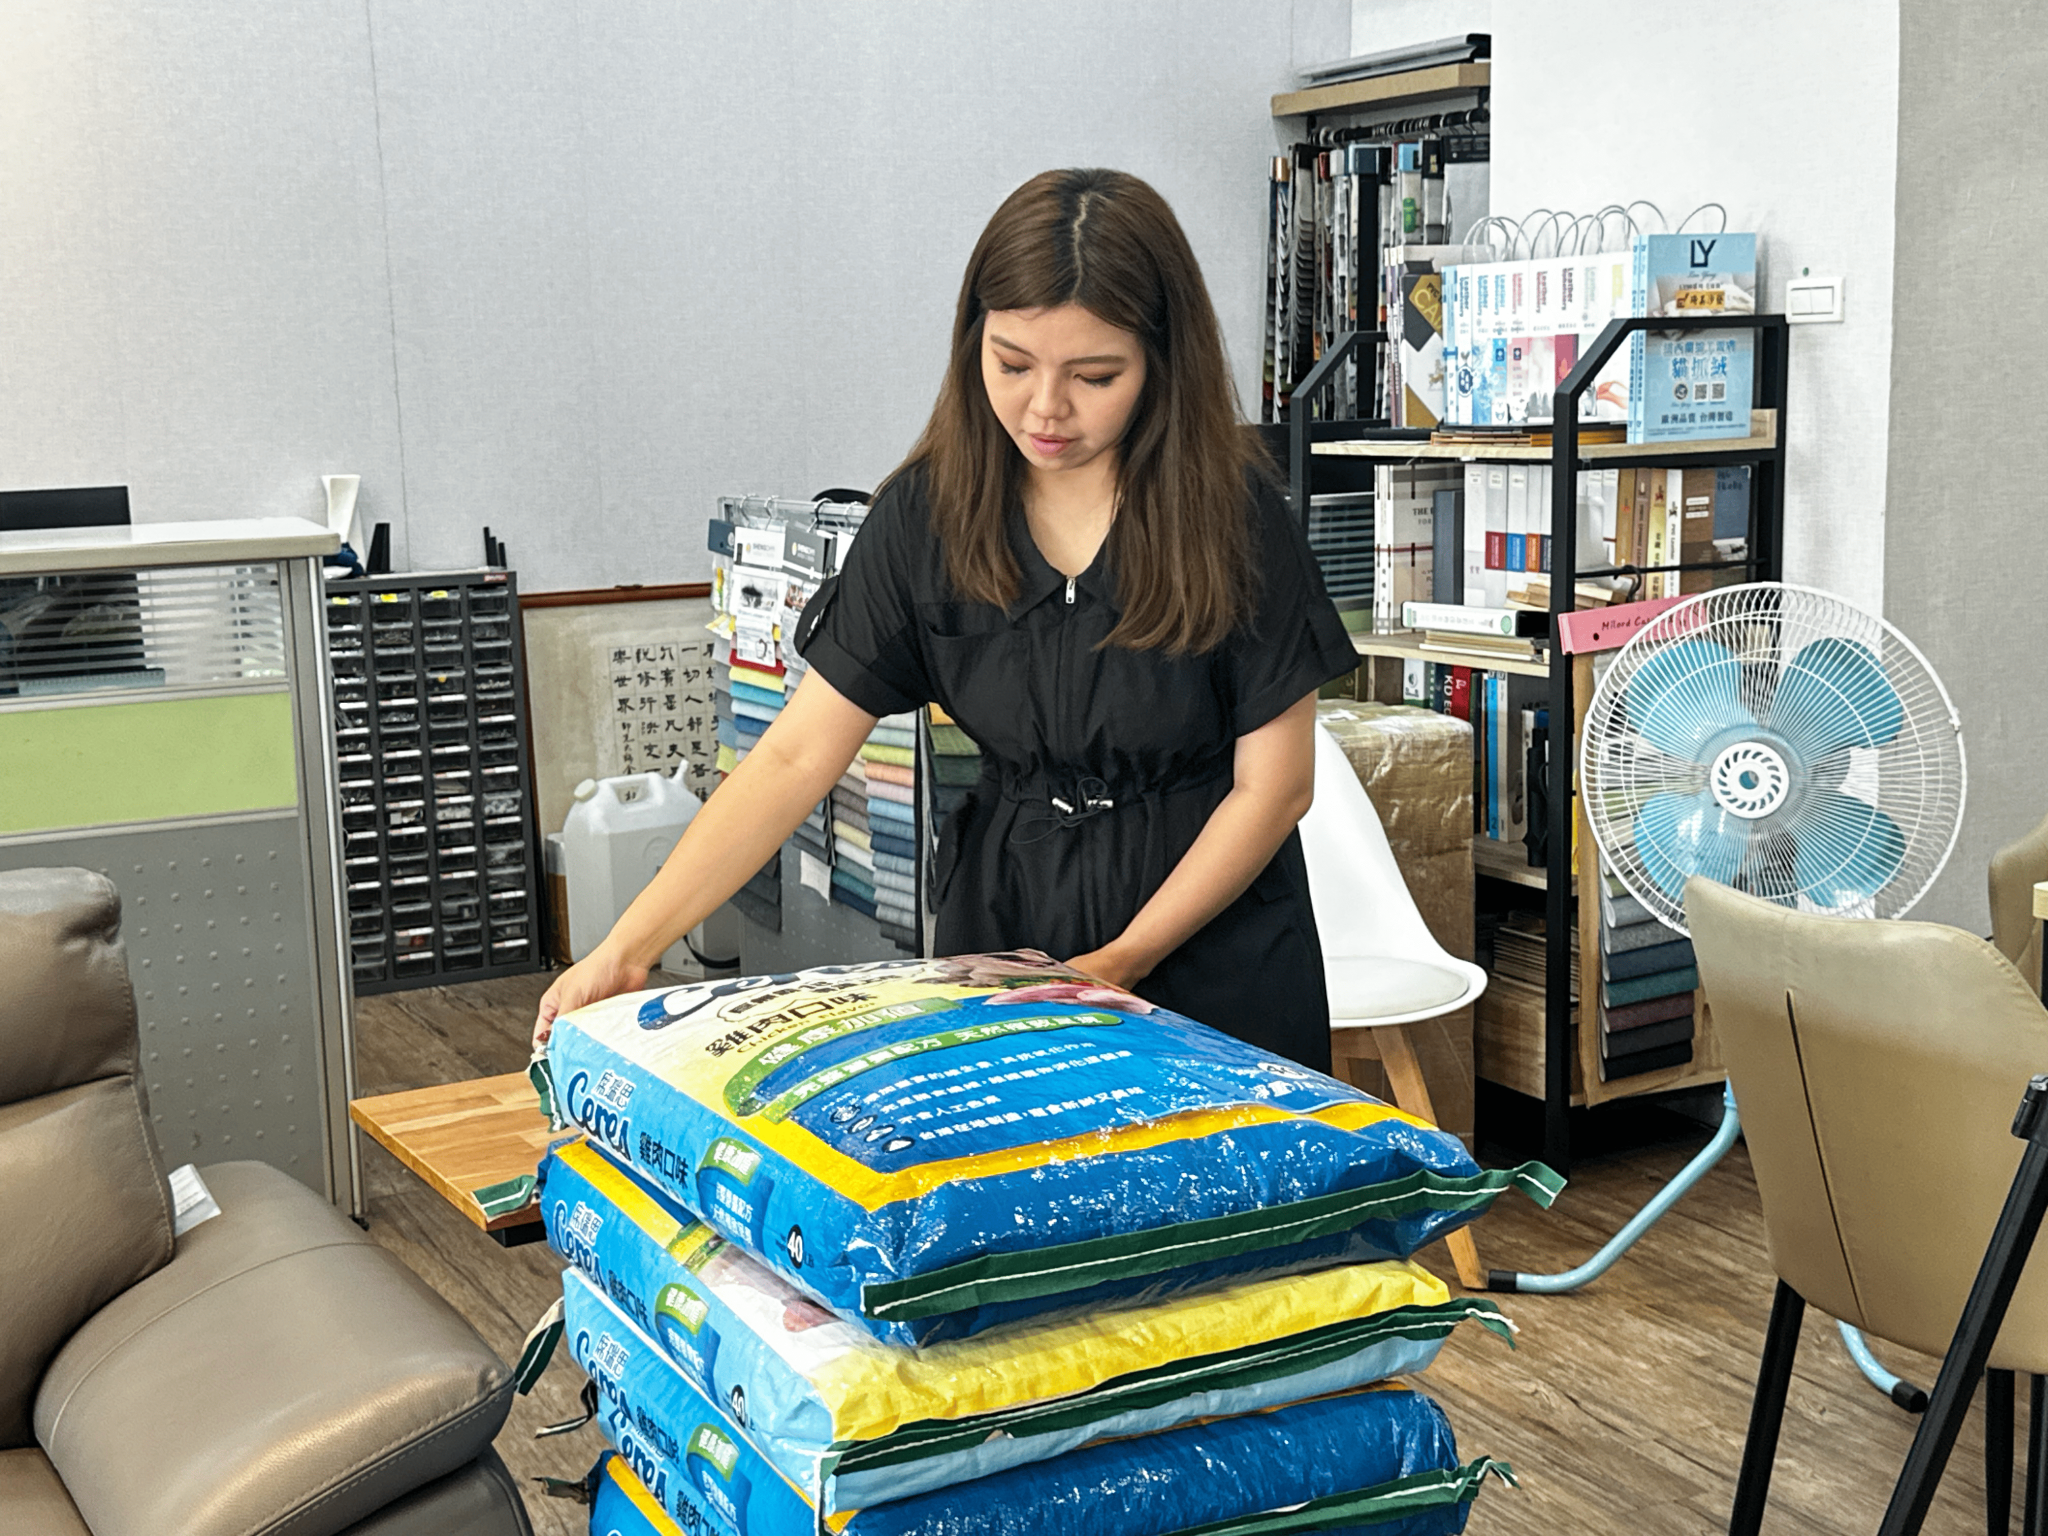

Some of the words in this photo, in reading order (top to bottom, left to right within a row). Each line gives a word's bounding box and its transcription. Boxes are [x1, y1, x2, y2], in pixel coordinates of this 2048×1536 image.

[1689, 239, 1717, 268] LY
[705, 993, 879, 1057] 雞肉口味
[567, 1071, 632, 1161] Ceres
[639, 1131, 689, 1189] 雞肉口味
[787, 1231, 803, 1263] 40
